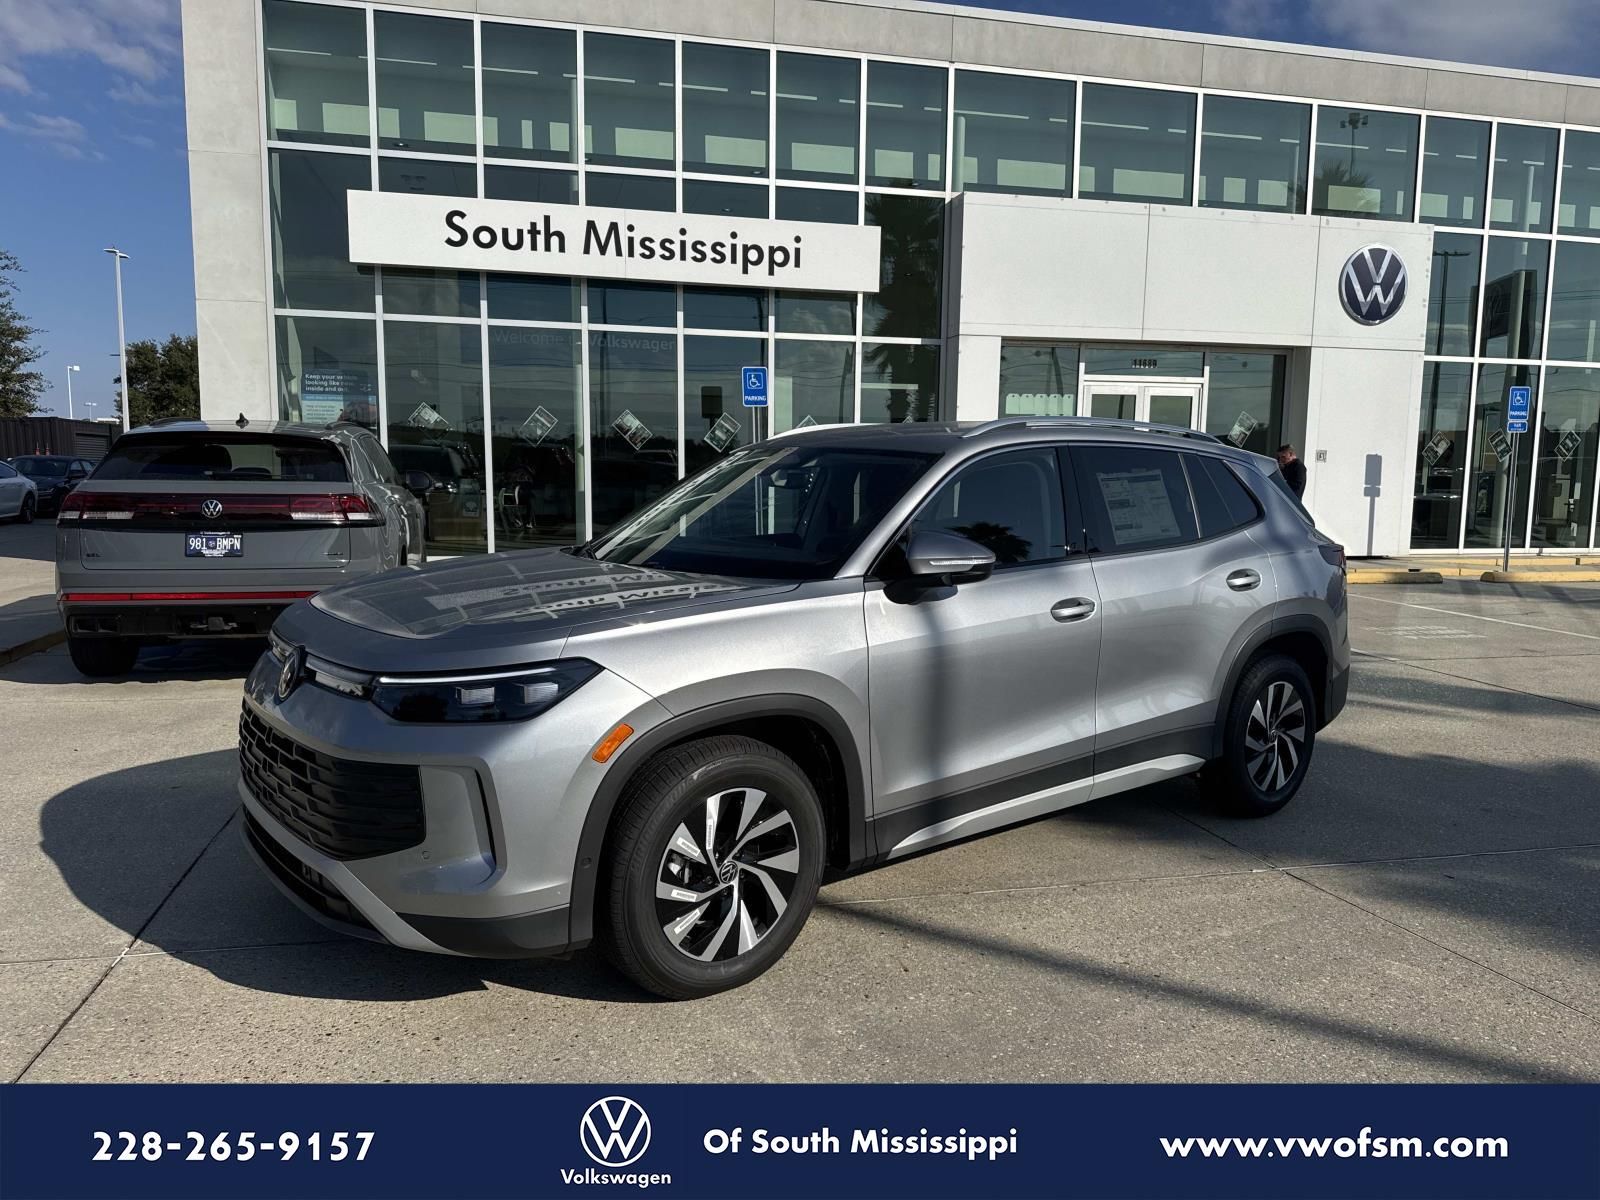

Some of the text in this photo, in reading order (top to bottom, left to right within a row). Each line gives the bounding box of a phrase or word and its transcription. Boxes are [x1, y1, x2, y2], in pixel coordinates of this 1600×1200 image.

[445, 210, 802, 276] South Mississippi
[494, 329, 565, 345] Welcome
[189, 537, 241, 550] 981 BMPN
